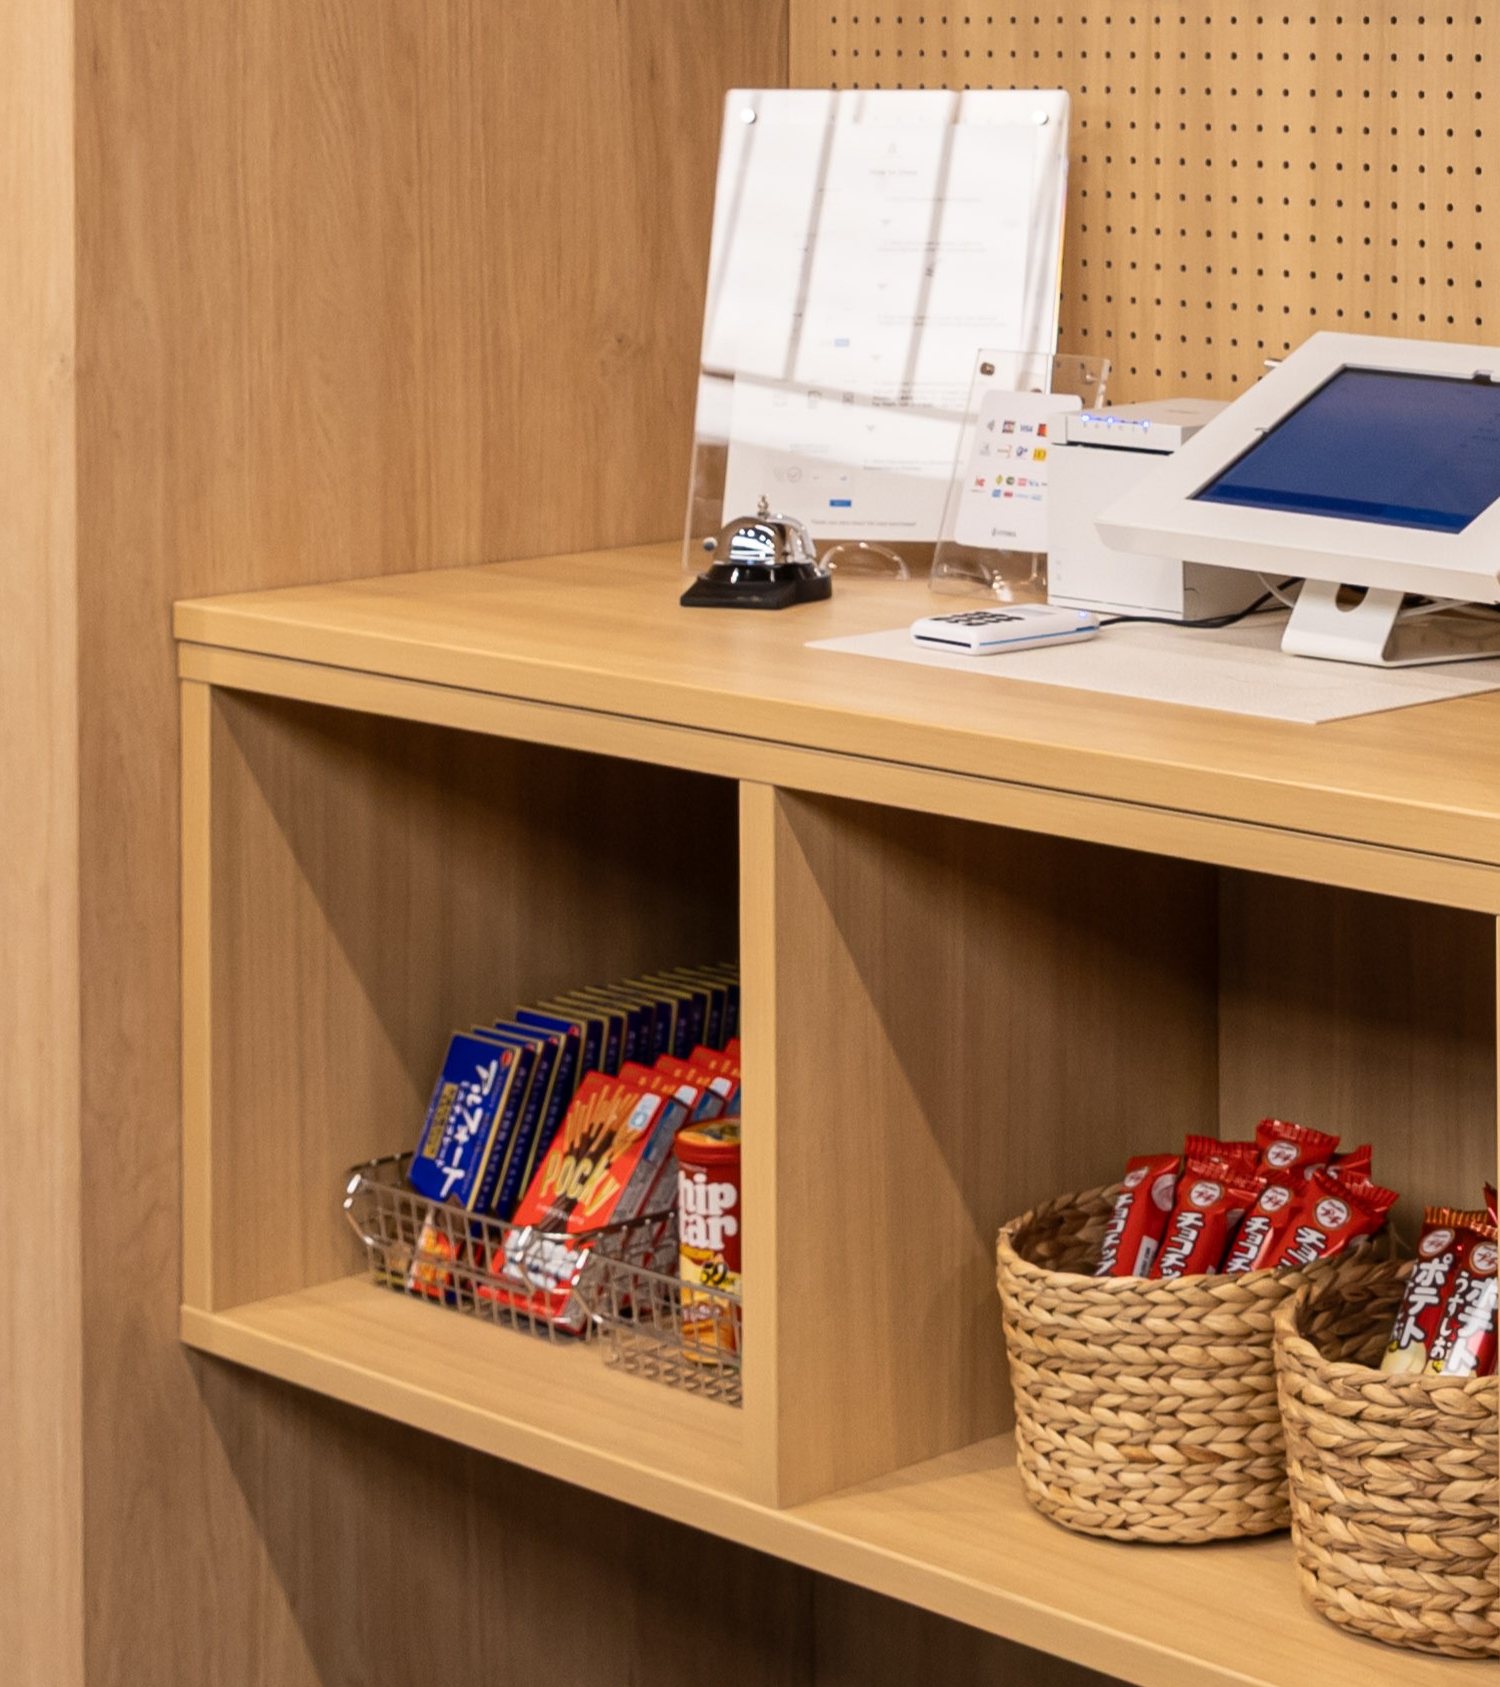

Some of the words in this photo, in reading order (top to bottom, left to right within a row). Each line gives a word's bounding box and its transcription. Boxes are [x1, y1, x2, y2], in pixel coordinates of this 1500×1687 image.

[1400, 1253, 1453, 1349] ポテト
[1429, 1270, 1469, 1359] うすしお
